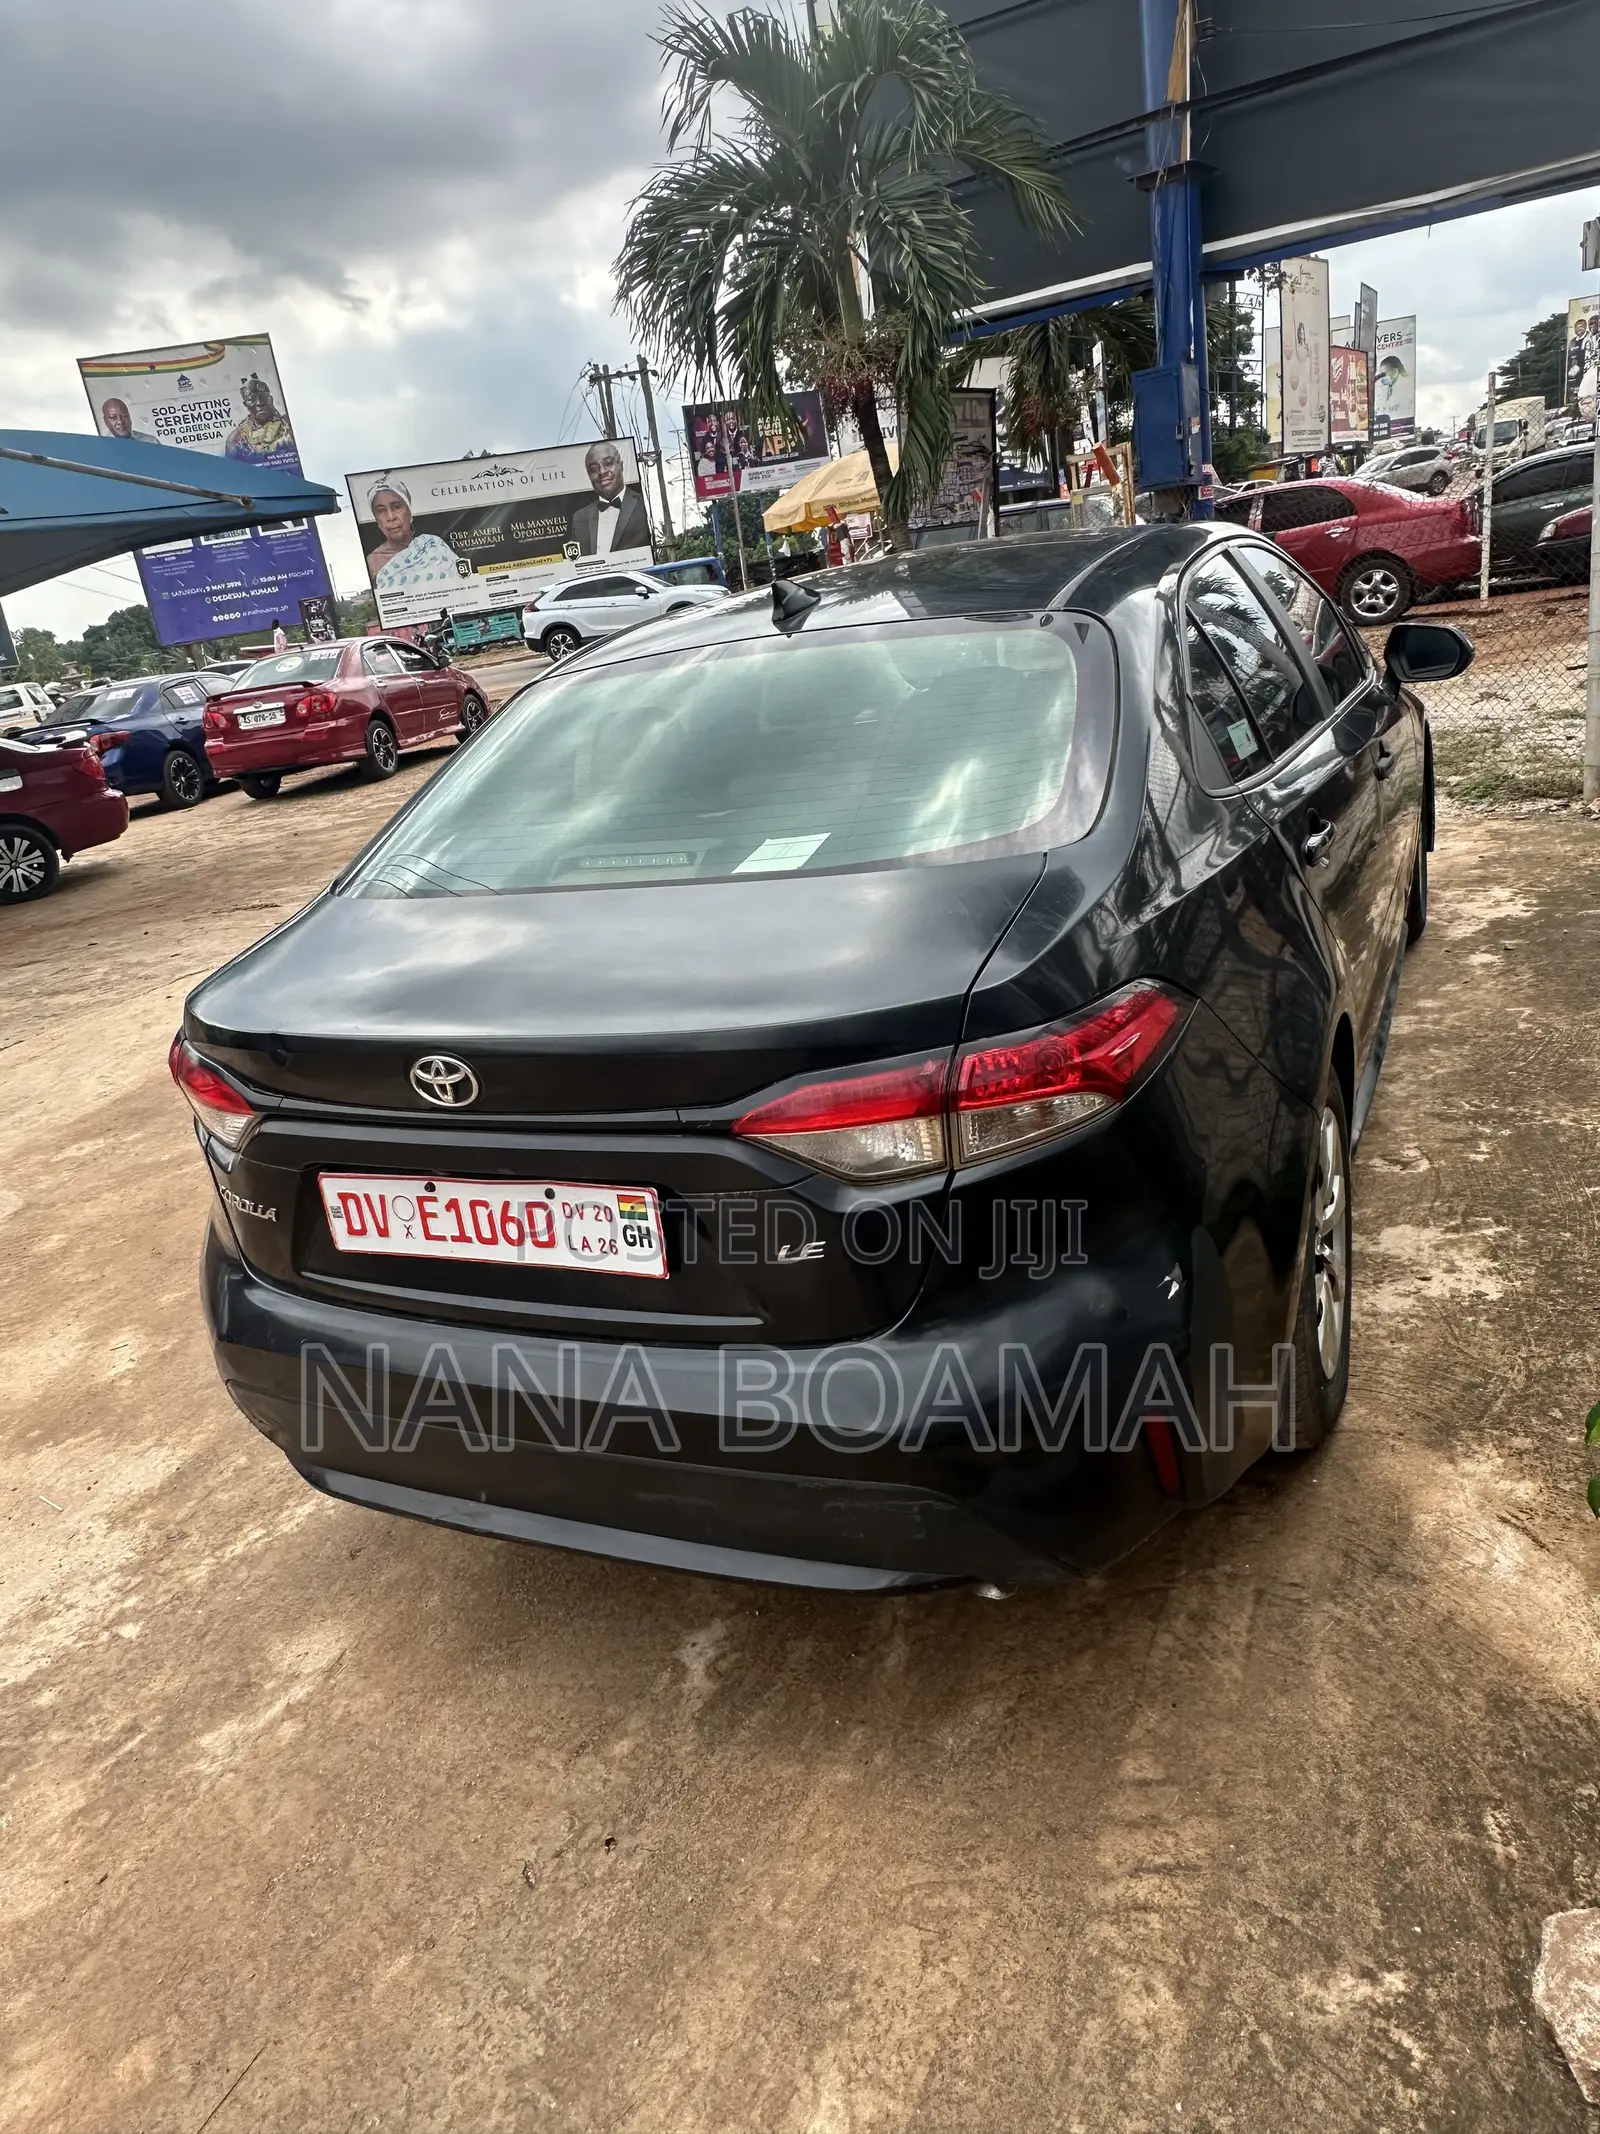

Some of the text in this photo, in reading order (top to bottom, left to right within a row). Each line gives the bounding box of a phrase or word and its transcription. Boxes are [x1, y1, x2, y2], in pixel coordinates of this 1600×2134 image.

[151, 398, 231, 417] SOD-CUTTING
[154, 407, 232, 428] CEREMONY
[156, 419, 237, 437] FOR GREEN CITY,
[175, 430, 224, 445] DEDESUA
[431, 470, 567, 497] CELEBRATION OF LIFE
[510, 515, 568, 532] MR MAXWELL
[513, 527, 545, 540] OPOKU
[546, 523, 568, 536] SIAW
[451, 533, 505, 549] TWUMWAAH
[277, 573, 288, 581] AM
[458, 563, 469, 574] 91
[219, 1185, 277, 1223] COROLLA
[561, 1201, 614, 1223] DV 20
[337, 1191, 558, 1249] DV E1060
[567, 1234, 619, 1256] LA 26
[622, 1224, 654, 1249] GH
[777, 1240, 827, 1262] LE
